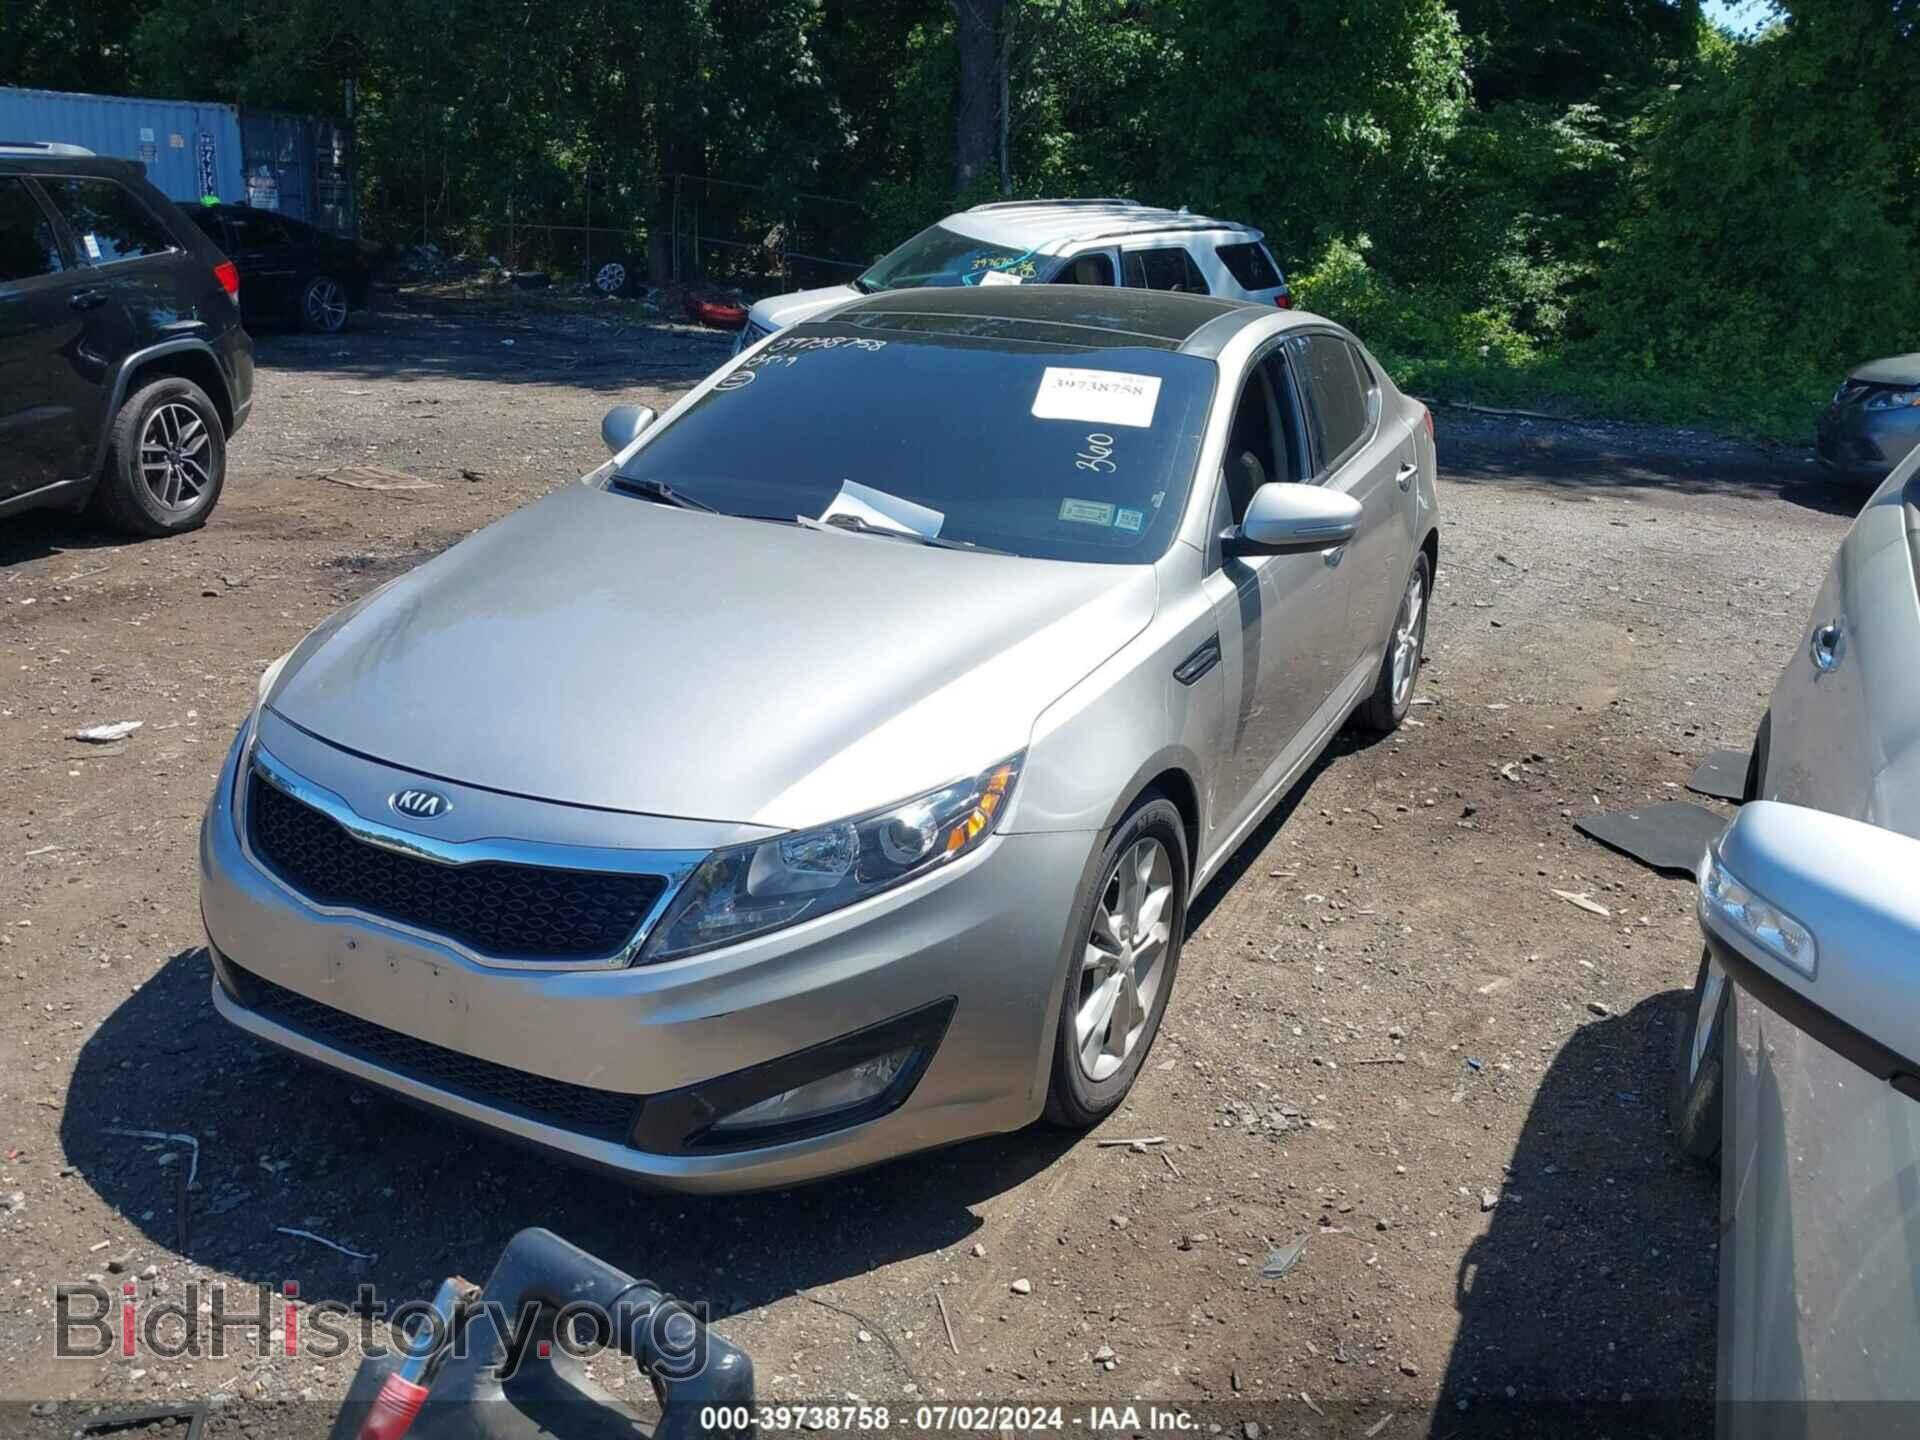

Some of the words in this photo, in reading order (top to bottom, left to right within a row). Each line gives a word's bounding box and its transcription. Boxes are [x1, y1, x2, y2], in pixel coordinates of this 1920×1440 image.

[1051, 378, 1144, 396] 39738758
[1075, 432, 1117, 474] 360
[398, 790, 439, 815] KIA
